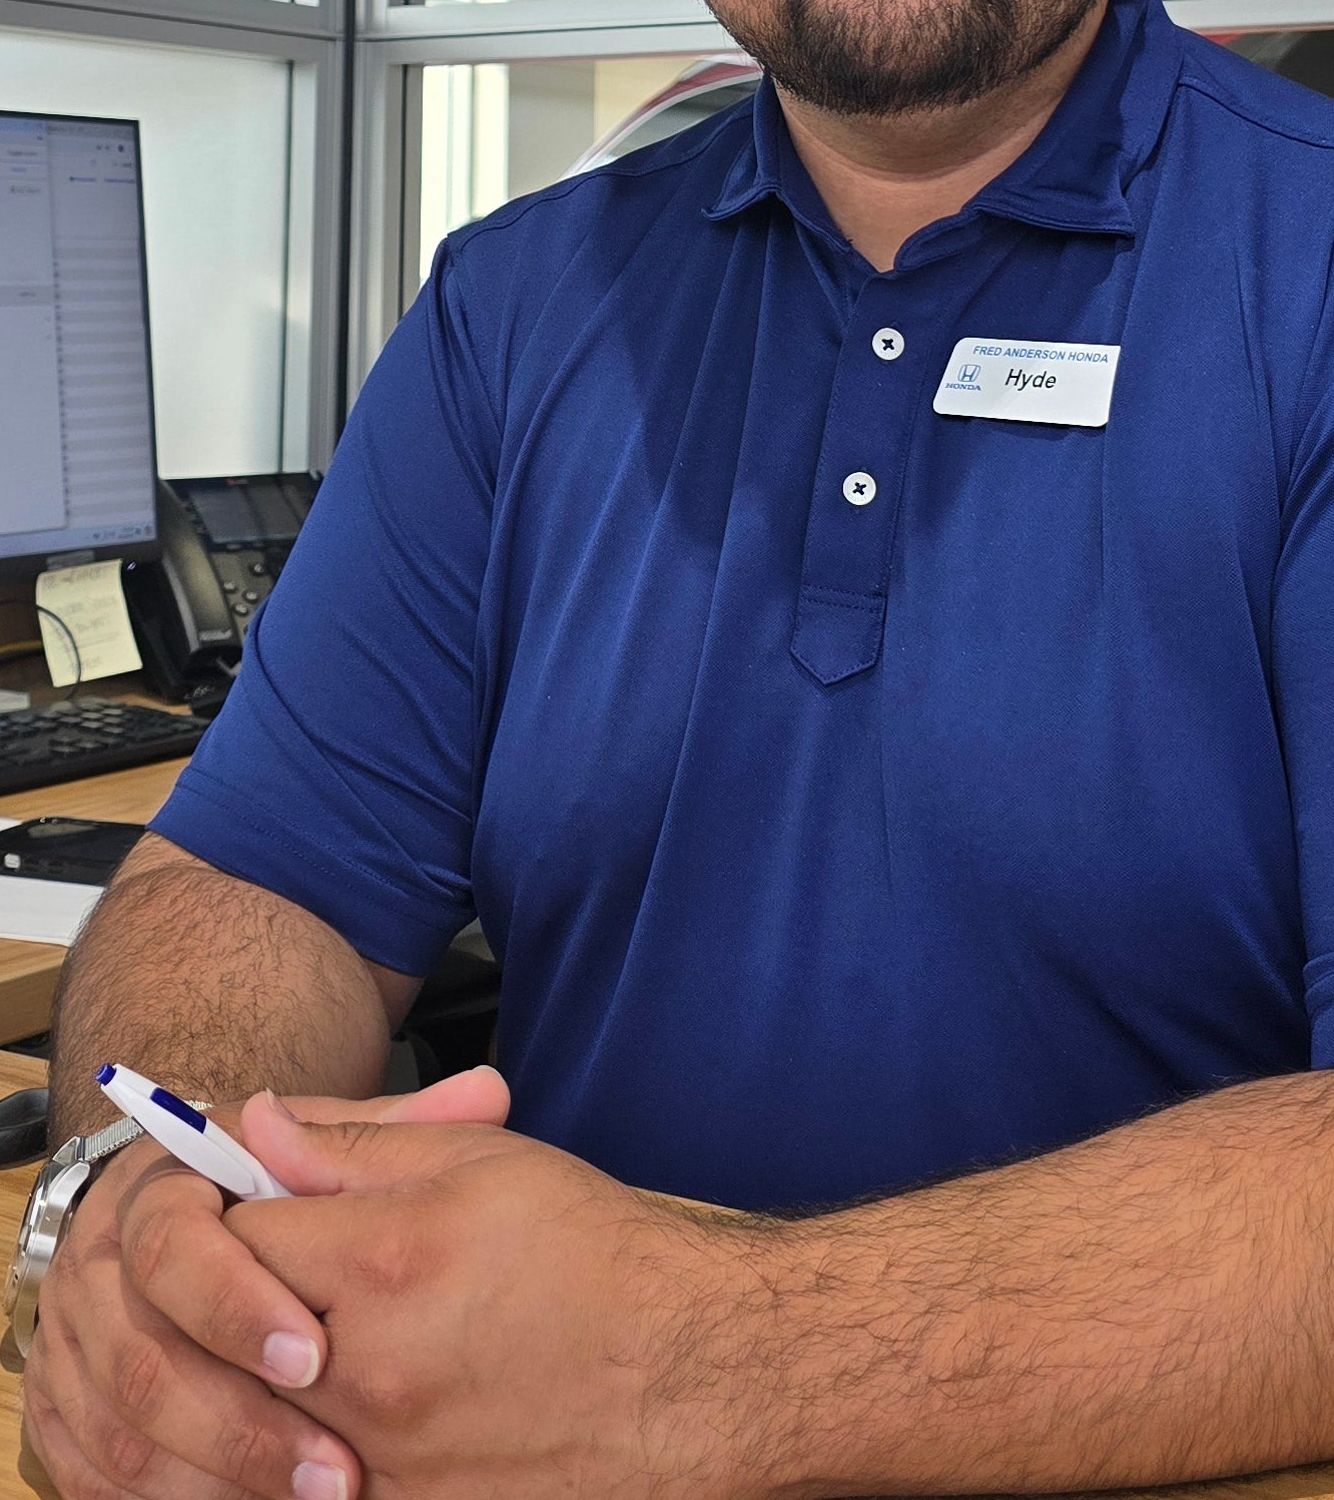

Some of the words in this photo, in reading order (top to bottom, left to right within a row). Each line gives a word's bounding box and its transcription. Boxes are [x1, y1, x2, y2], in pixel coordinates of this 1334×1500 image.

[972, 345, 1003, 356] FRED
[1004, 348, 1066, 360] ANDERSON
[1067, 351, 1109, 363] HONDA
[945, 382, 982, 391] HONDA
[1005, 368, 1057, 392] Hyde
